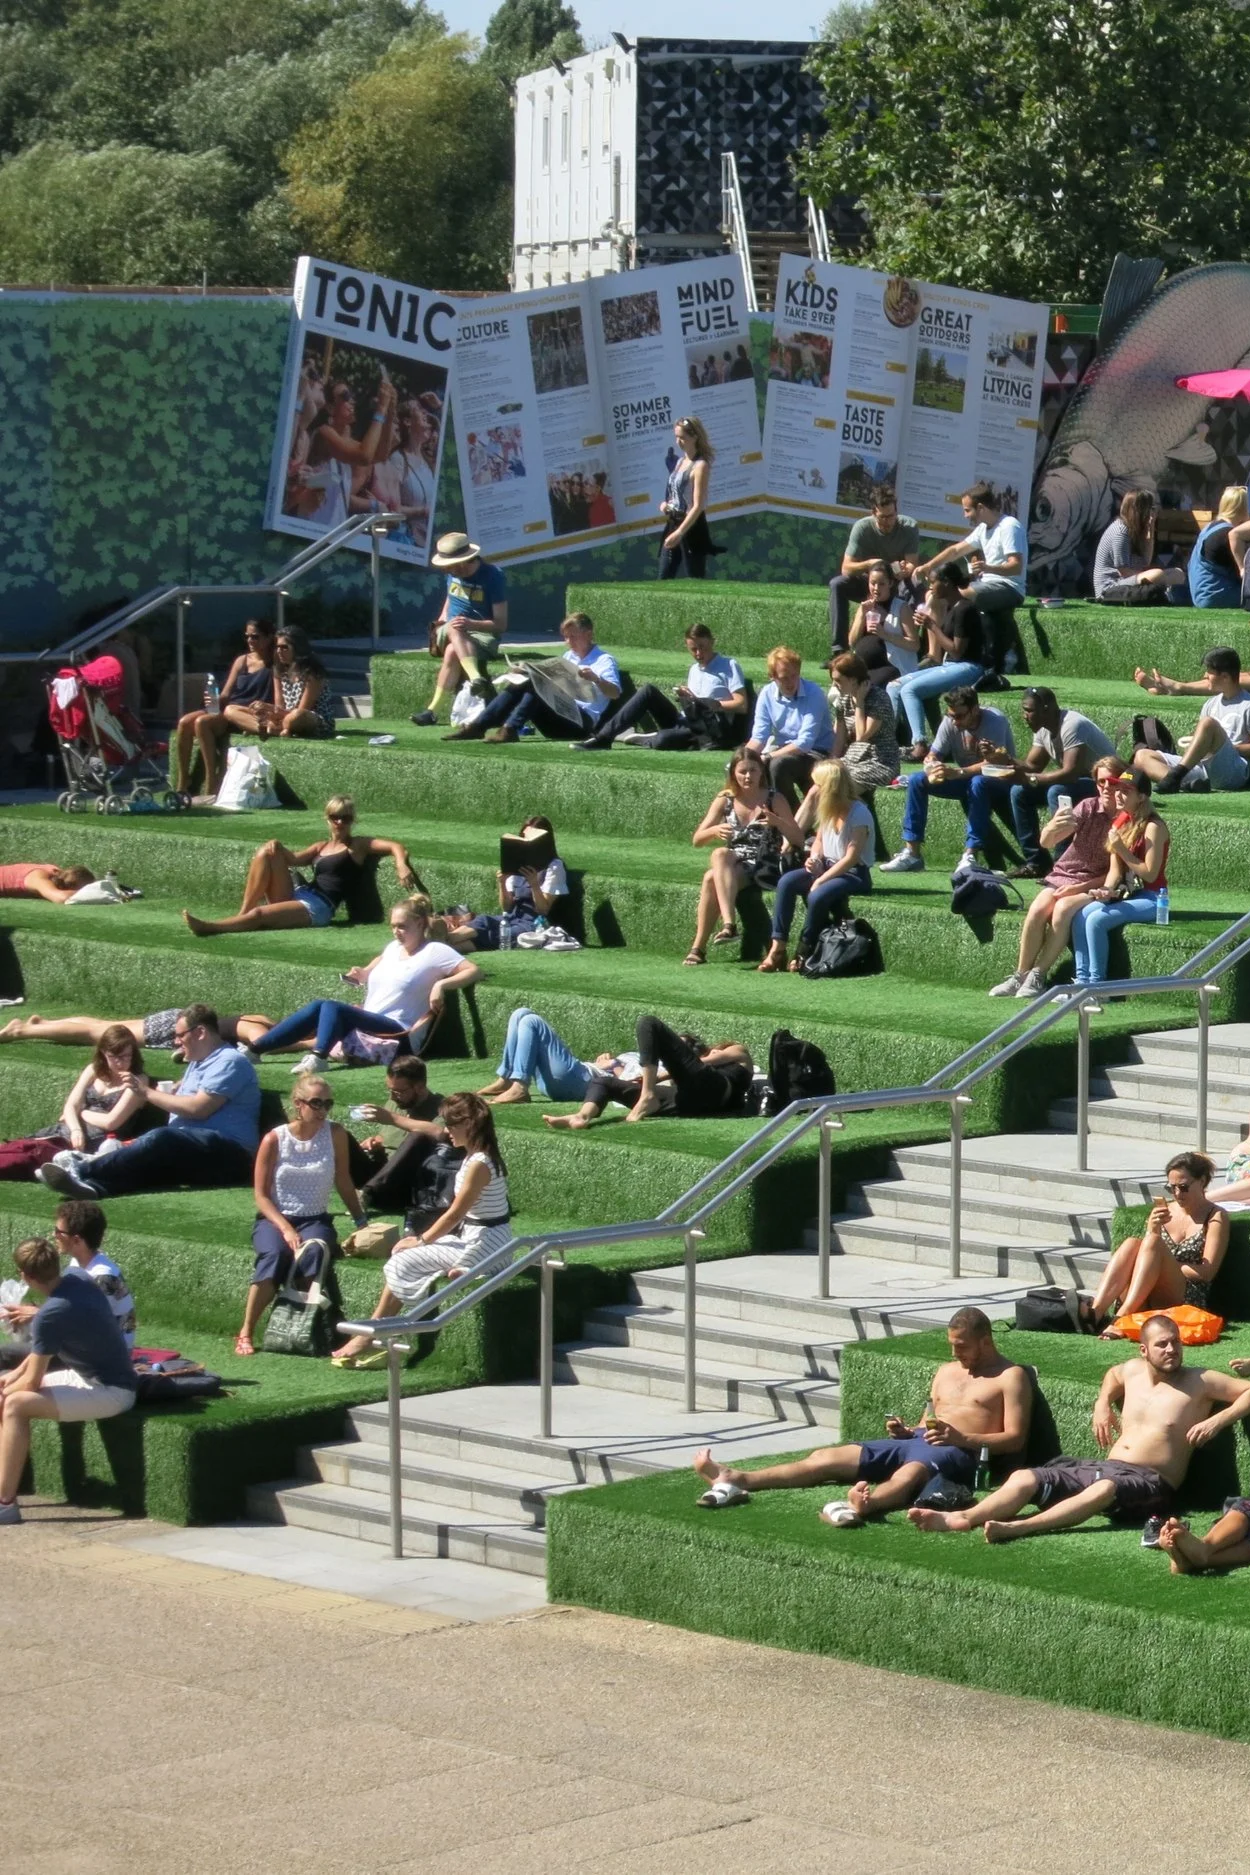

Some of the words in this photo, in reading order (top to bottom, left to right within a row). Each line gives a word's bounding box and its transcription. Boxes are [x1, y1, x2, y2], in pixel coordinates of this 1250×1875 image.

[677, 278, 735, 308] MIND
[785, 278, 838, 312] KIDS
[313, 267, 457, 351] TONIC
[680, 305, 739, 336] FUEL
[785, 305, 808, 320] TAKE
[811, 310, 836, 325] OVER
[921, 306, 973, 331] GREAT
[919, 325, 971, 344] OUTDOORS
[983, 375, 1032, 400] LIVING
[612, 396, 672, 419] SUMMER
[845, 404, 885, 427] TASTE
[614, 418, 630, 434] OF
[635, 410, 672, 429] SPORT
[842, 423, 883, 446] BUDS
